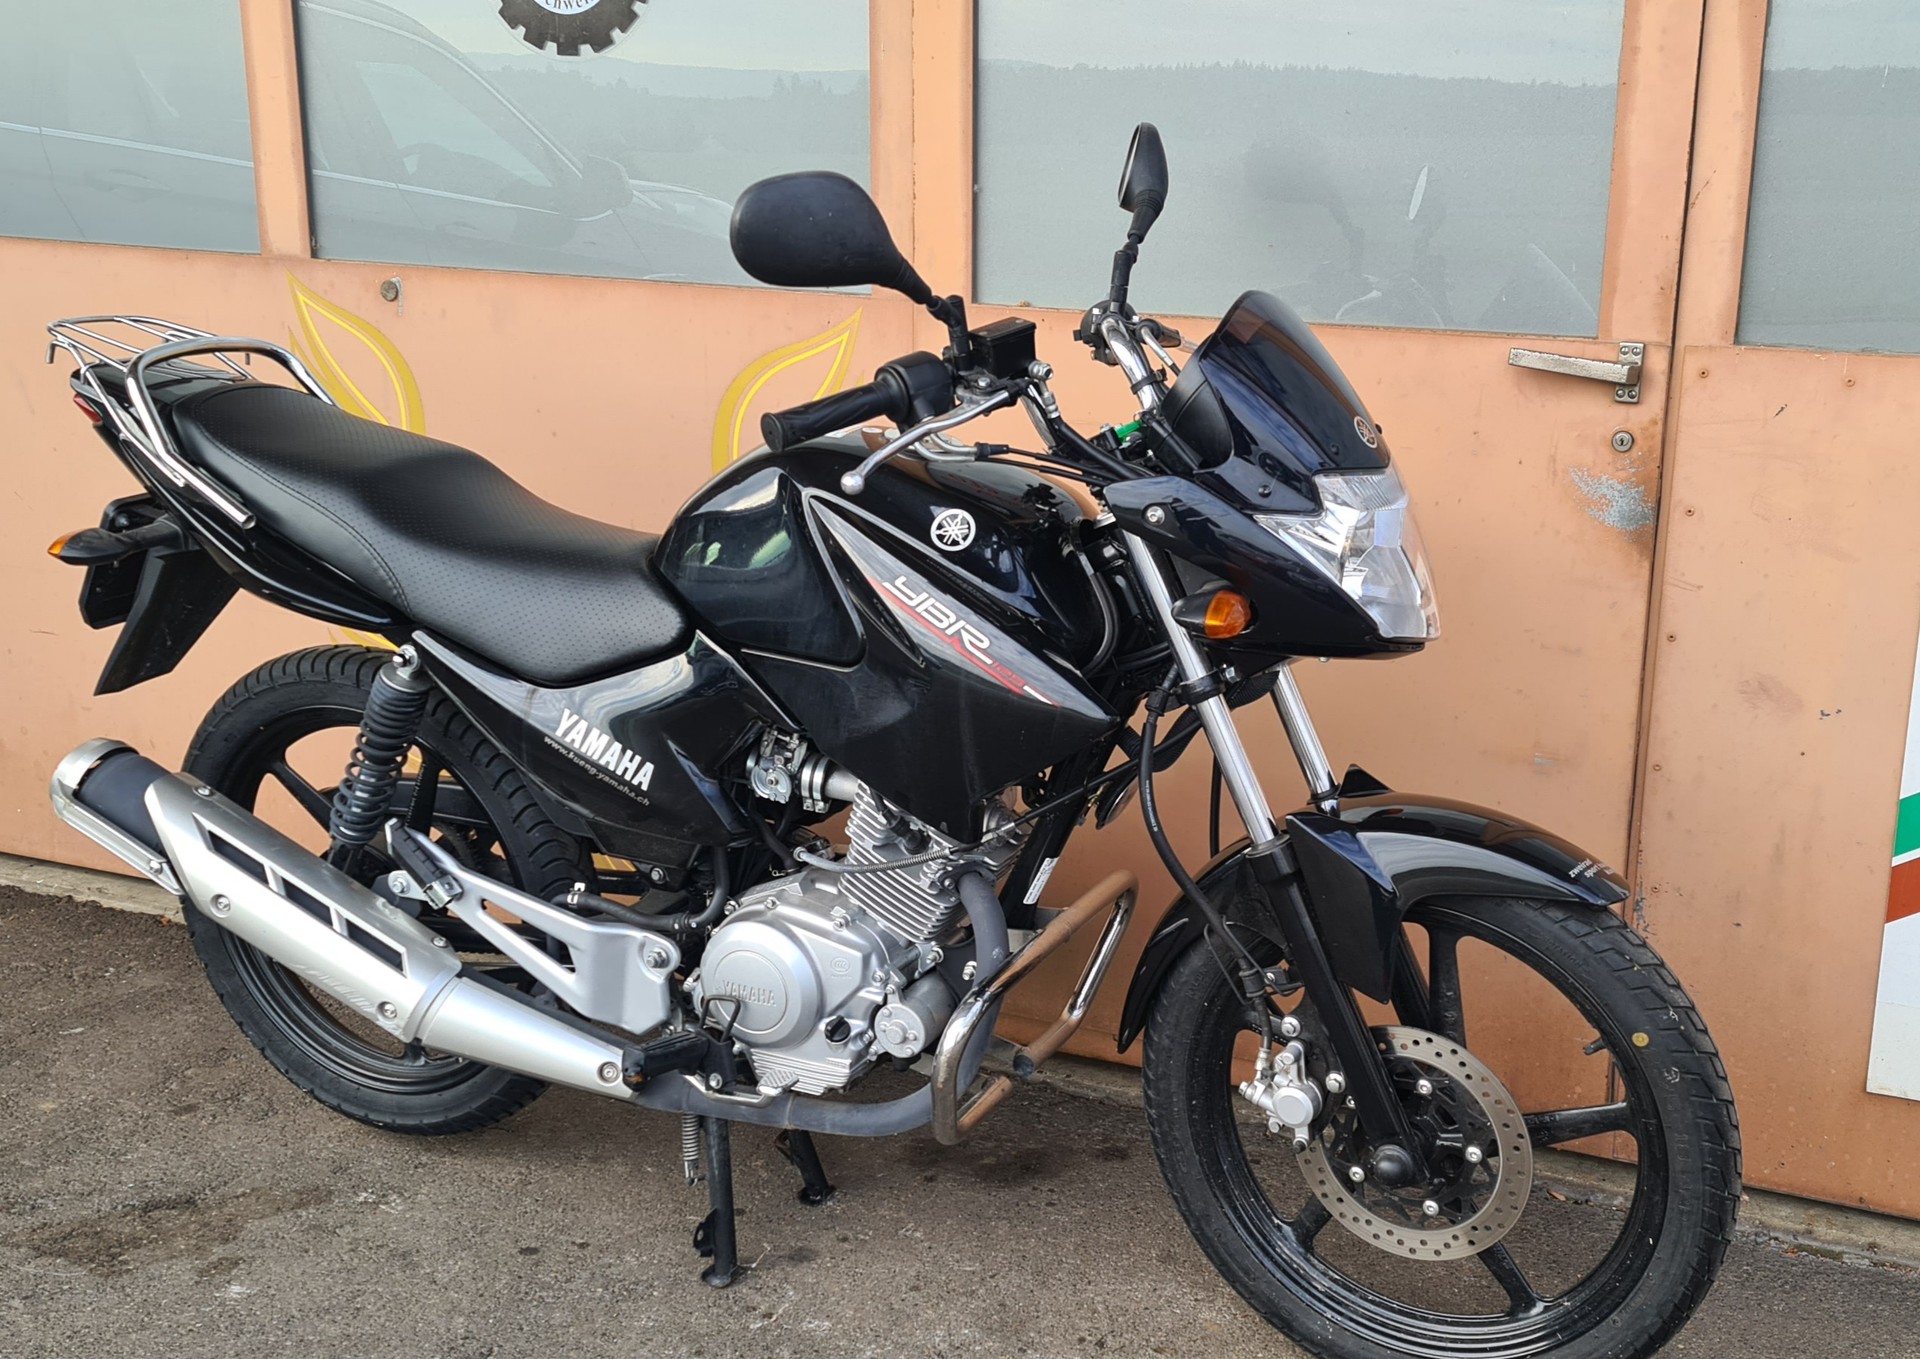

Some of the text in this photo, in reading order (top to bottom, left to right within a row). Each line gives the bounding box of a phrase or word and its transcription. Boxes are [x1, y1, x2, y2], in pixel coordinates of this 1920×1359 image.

[882, 576, 993, 665] YBR
[544, 736, 650, 806] www.kueng-yamaha.ch
[555, 708, 655, 792] YAMAHA
[722, 979, 777, 1007] YAMAHA
